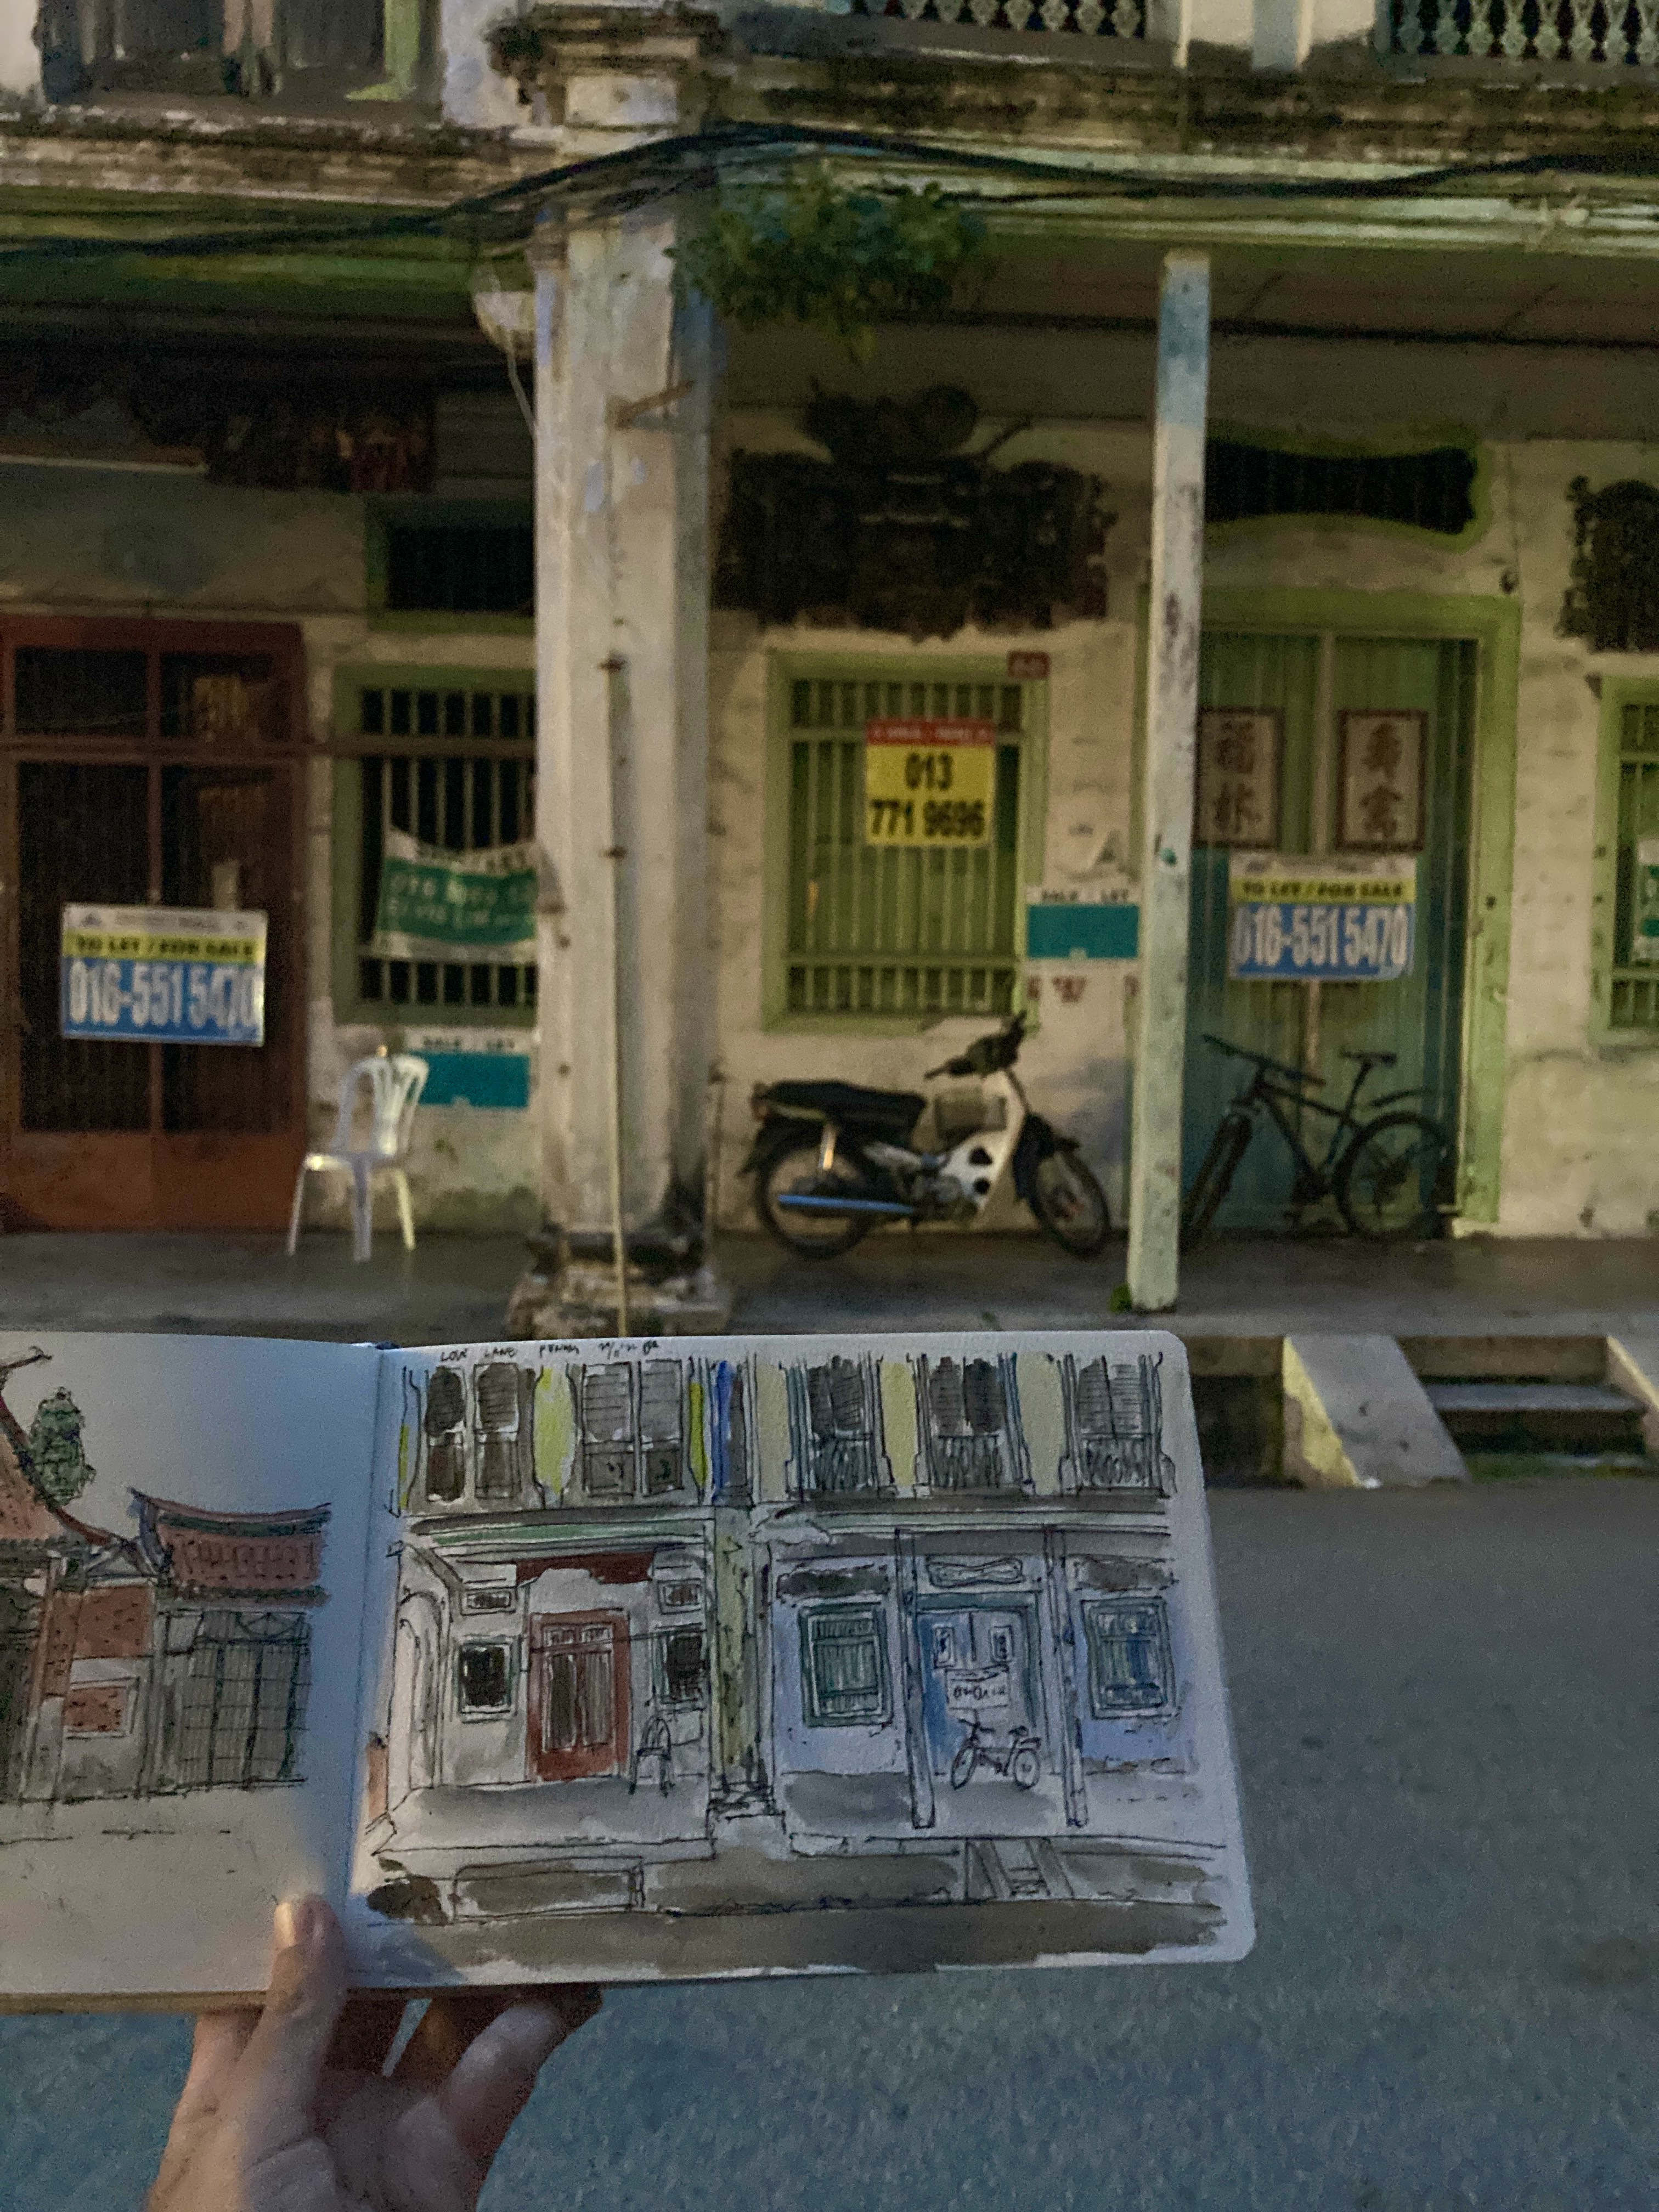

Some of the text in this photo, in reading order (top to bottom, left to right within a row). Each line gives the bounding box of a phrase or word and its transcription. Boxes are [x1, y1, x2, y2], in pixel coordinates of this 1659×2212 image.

[905, 751, 954, 790] 013
[870, 798, 915, 837] 771
[1242, 881, 1265, 896] TO
[1269, 881, 1302, 896] LET
[1317, 881, 1356, 897] FOR
[1359, 882, 1403, 898] SALE
